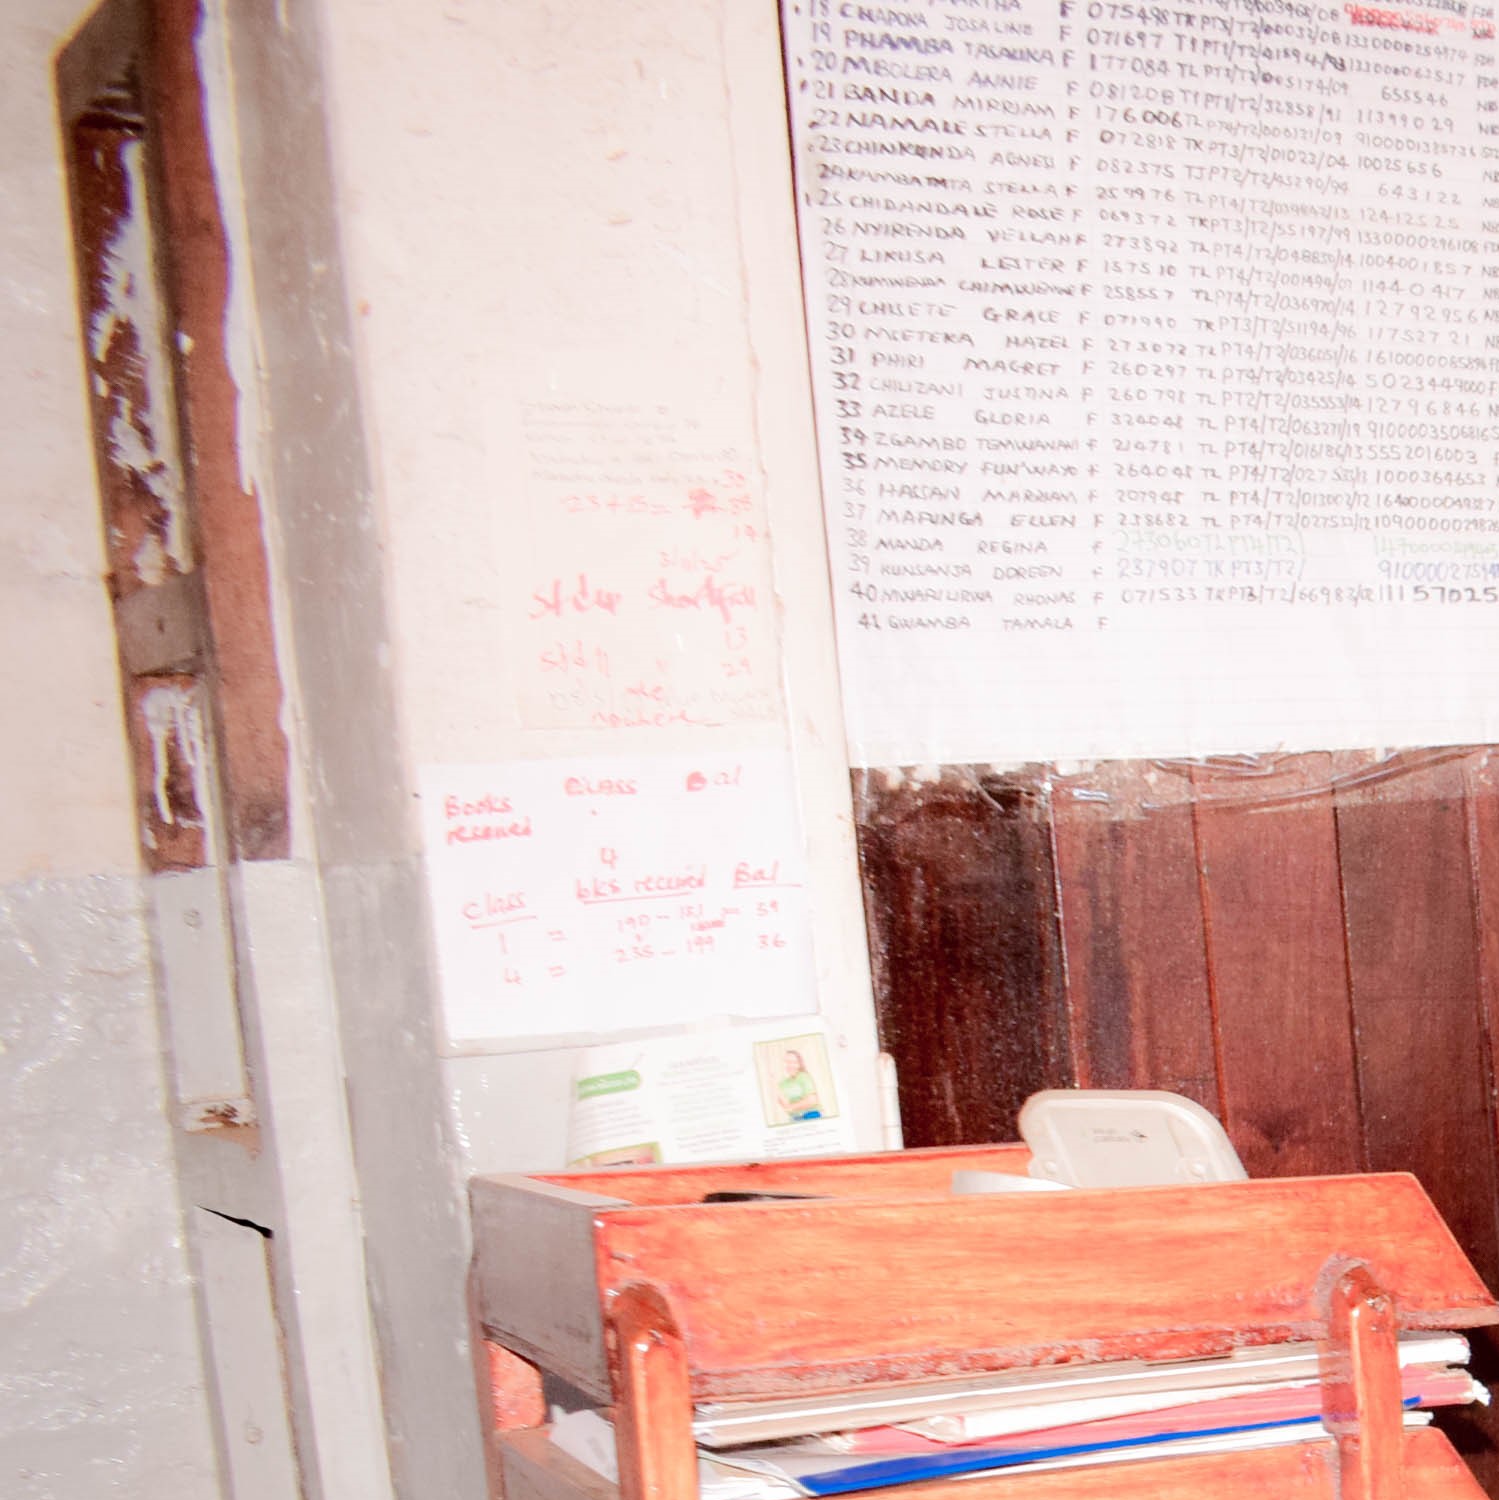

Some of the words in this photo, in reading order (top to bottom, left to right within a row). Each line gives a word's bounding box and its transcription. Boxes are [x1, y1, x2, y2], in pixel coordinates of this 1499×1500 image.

[831, 345, 856, 366] 31
[832, 370, 861, 392] 32
[834, 398, 862, 420] 33
